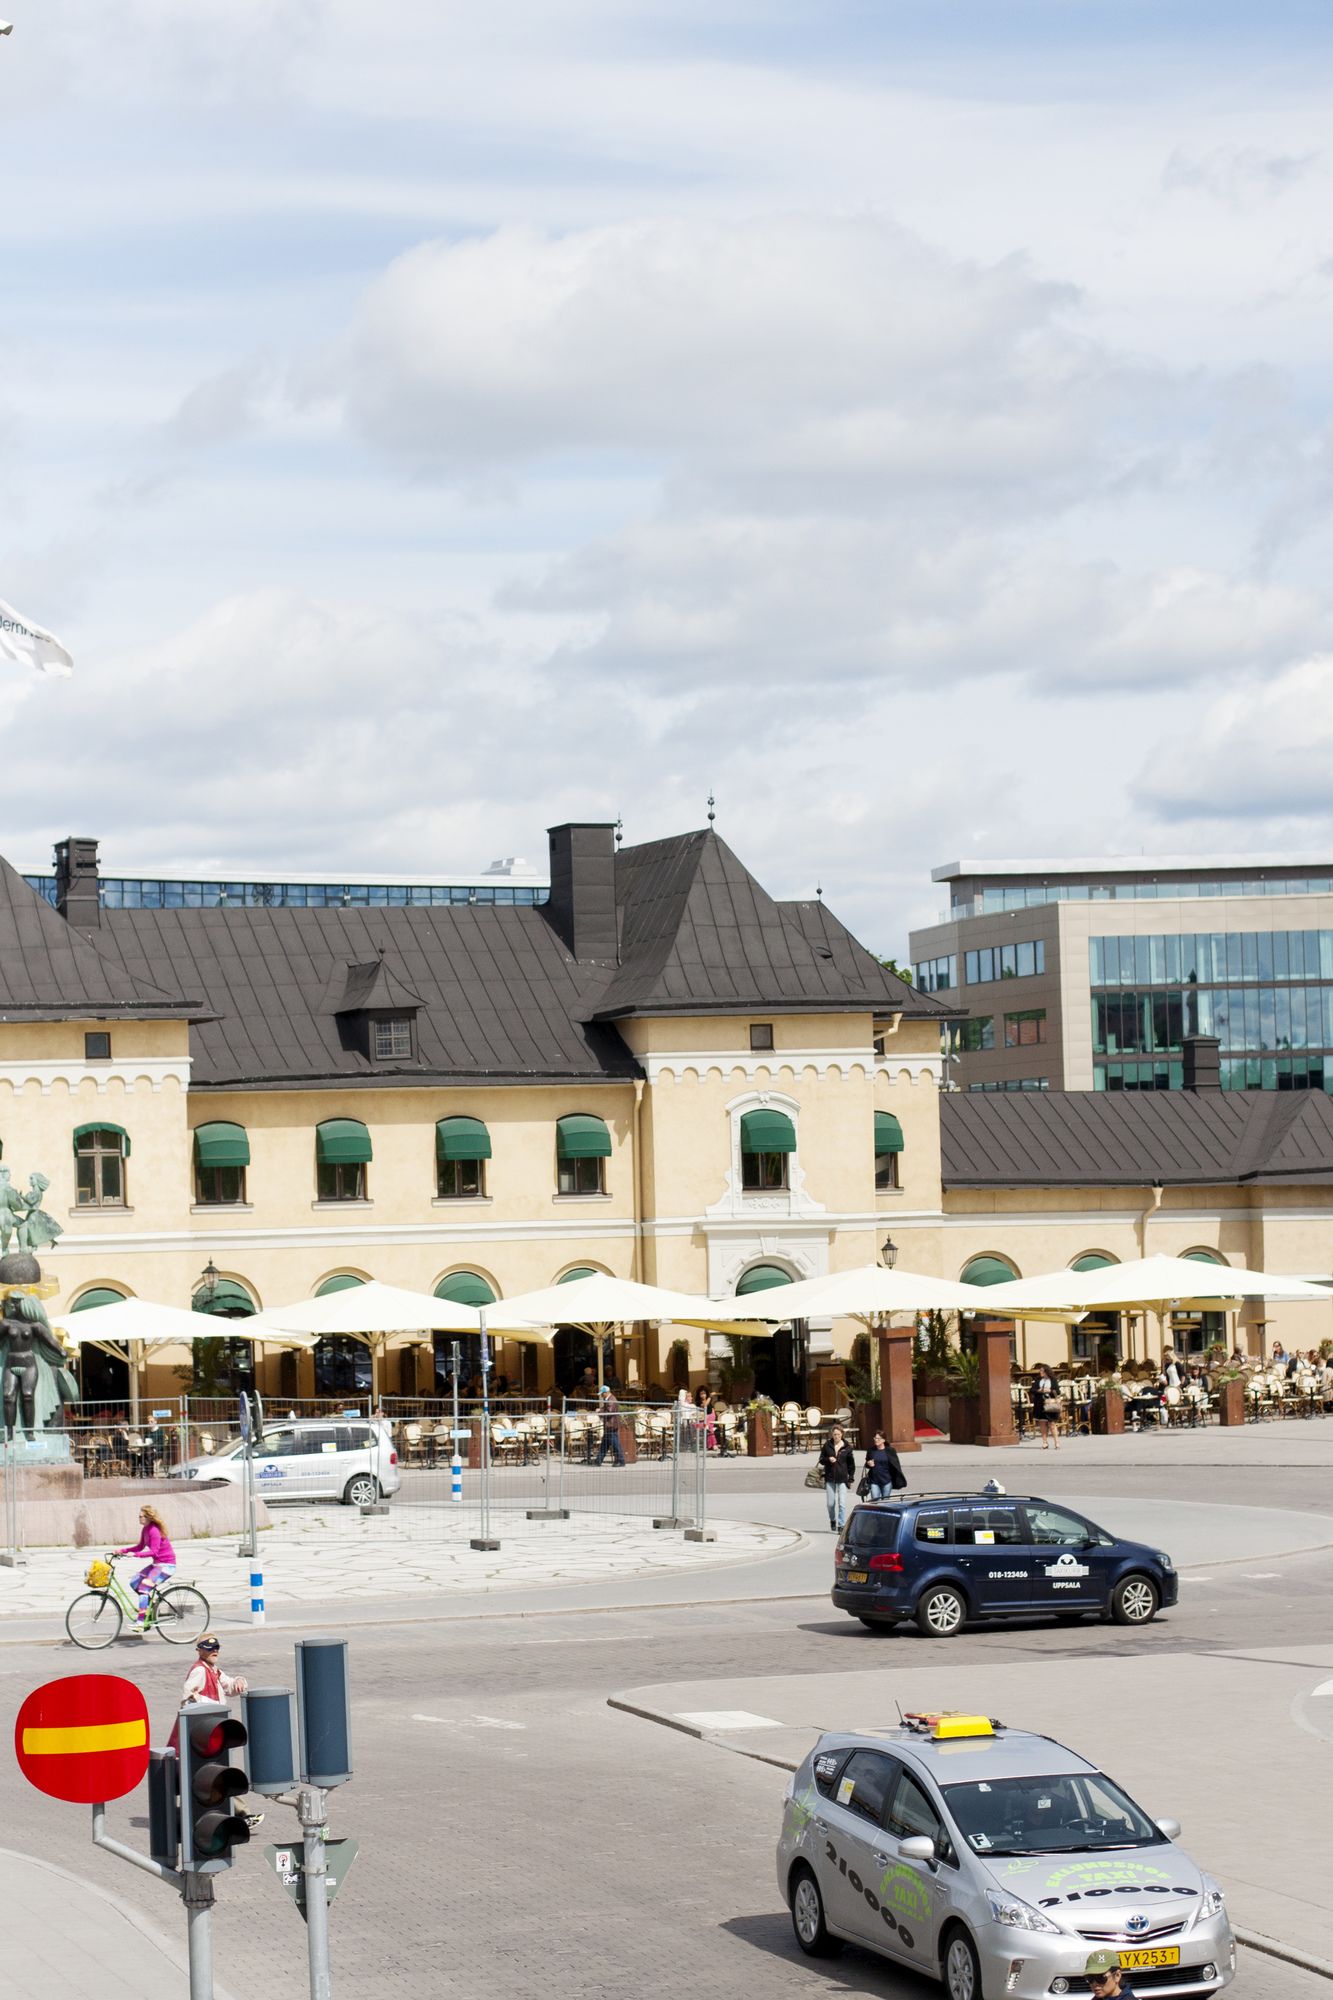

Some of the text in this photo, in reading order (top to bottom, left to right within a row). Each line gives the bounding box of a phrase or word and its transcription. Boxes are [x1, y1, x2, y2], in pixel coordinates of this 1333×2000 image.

[972, 1834, 984, 1846] F
[1078, 1870, 1137, 1882] TAXI
[826, 1840, 915, 1948] 210000
[1038, 1885, 1198, 1909] 210000
